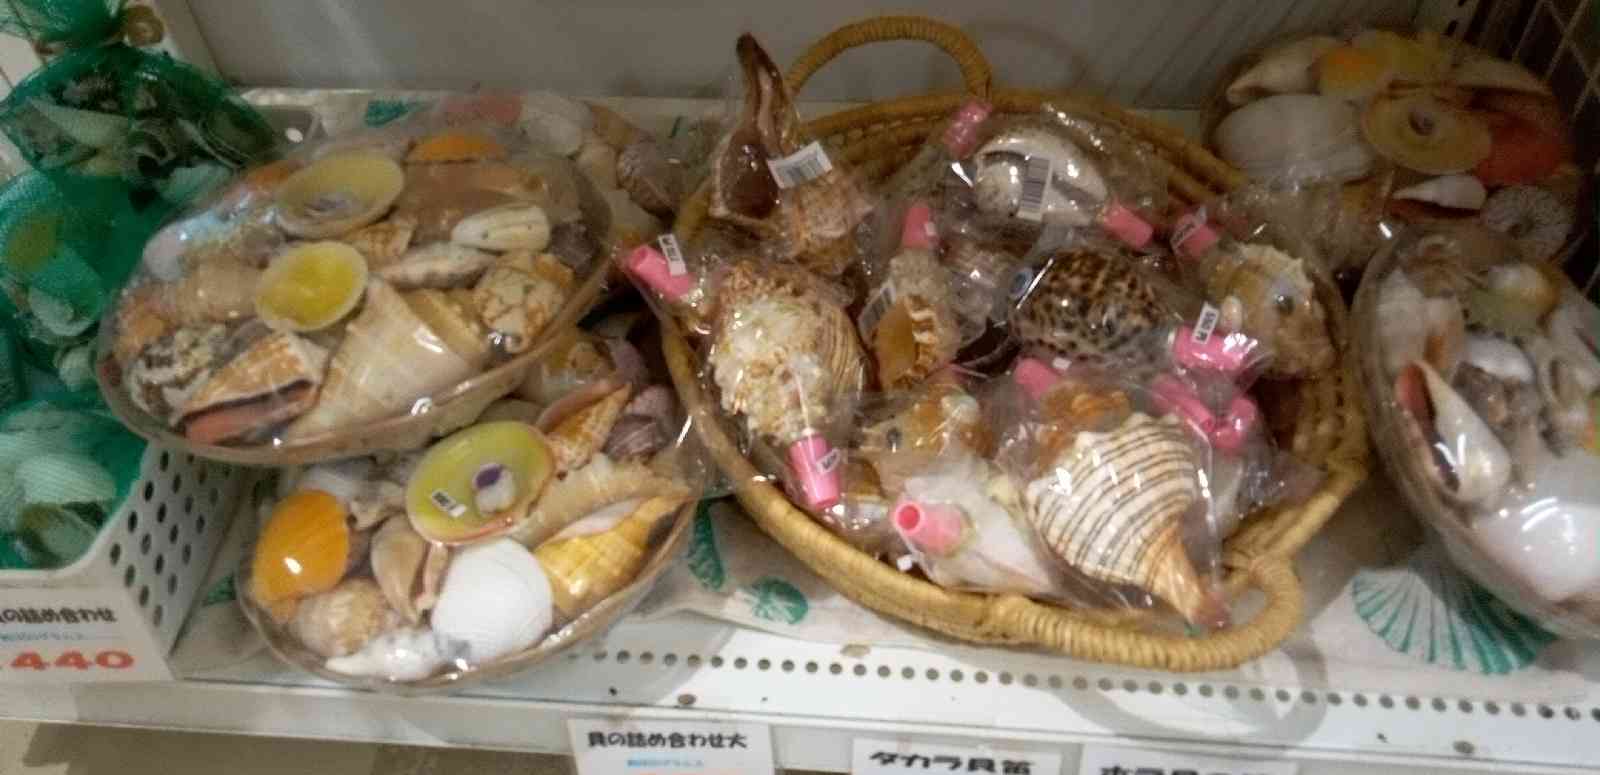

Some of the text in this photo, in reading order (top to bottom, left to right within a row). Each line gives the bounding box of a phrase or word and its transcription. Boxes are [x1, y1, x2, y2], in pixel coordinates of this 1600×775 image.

[0, 607, 117, 623] の詰め合わせ
[588, 731, 748, 748] 貝の詰め合わせ大
